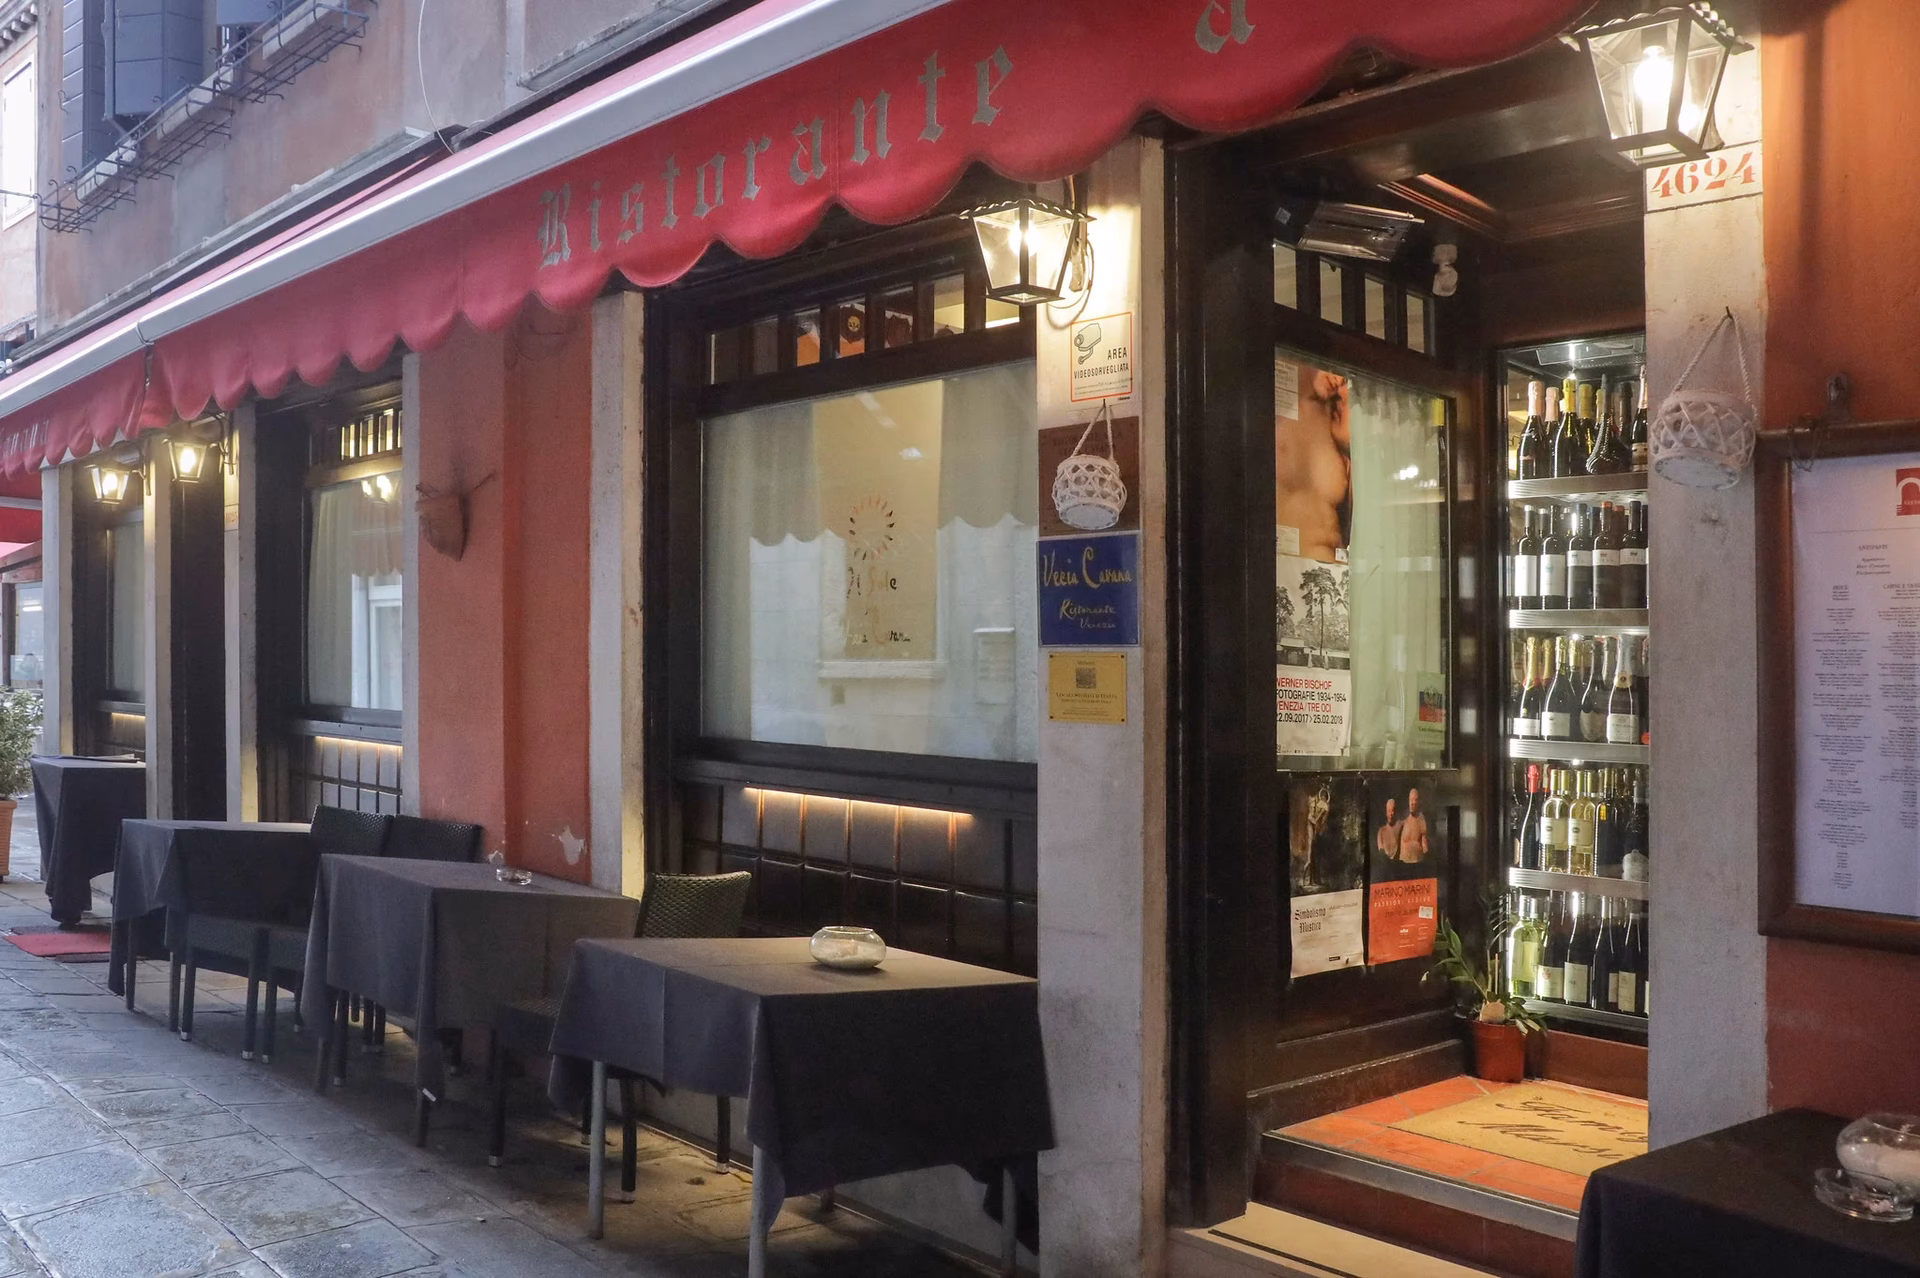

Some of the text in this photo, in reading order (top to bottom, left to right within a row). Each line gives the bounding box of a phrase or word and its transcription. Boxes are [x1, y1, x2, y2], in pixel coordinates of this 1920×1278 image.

[537, 44, 1013, 272] Ristorante
[1650, 151, 1756, 198] 4624
[1107, 346, 1128, 360] AREA
[1073, 362, 1130, 379] VIDEOSORVEGLIATA
[1043, 549, 1080, 587] Vecia
[1305, 680, 1332, 689] BISCHOF
